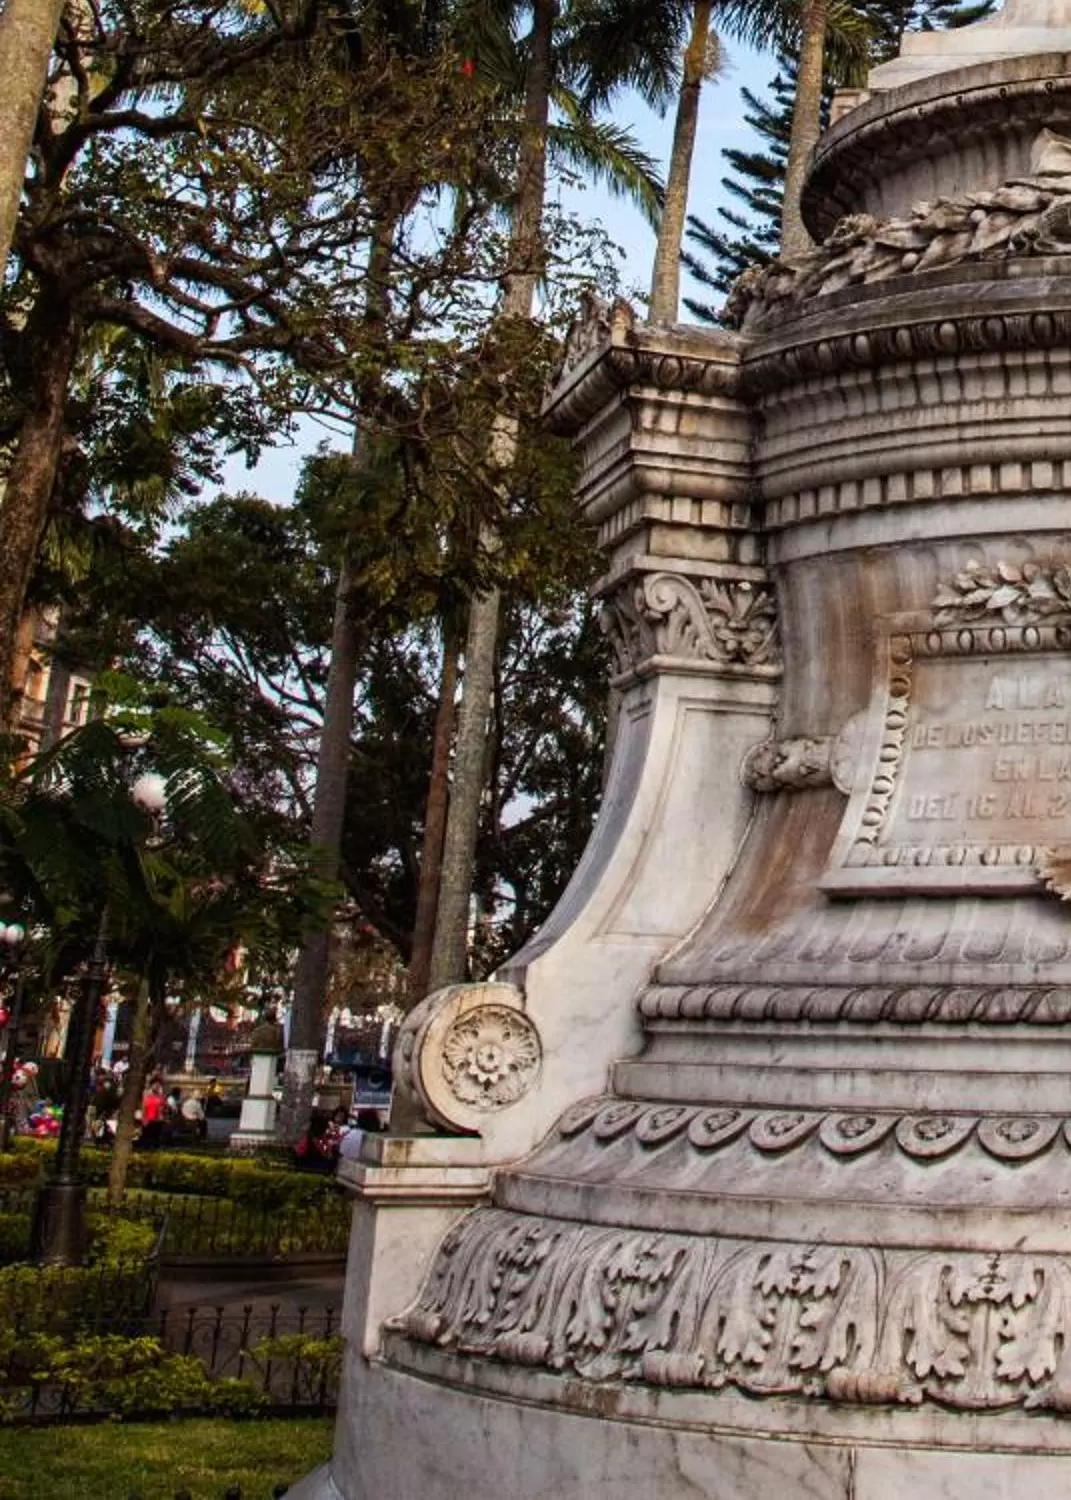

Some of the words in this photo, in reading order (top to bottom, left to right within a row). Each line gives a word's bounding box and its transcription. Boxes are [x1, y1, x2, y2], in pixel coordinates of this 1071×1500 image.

[985, 675, 1005, 710] A
[1016, 674, 1065, 710] LA
[911, 722, 944, 751] DE
[944, 722, 994, 750] LOS
[991, 755, 1029, 783] EN
[907, 791, 960, 822] DEL
[1004, 788, 1038, 821] AL
